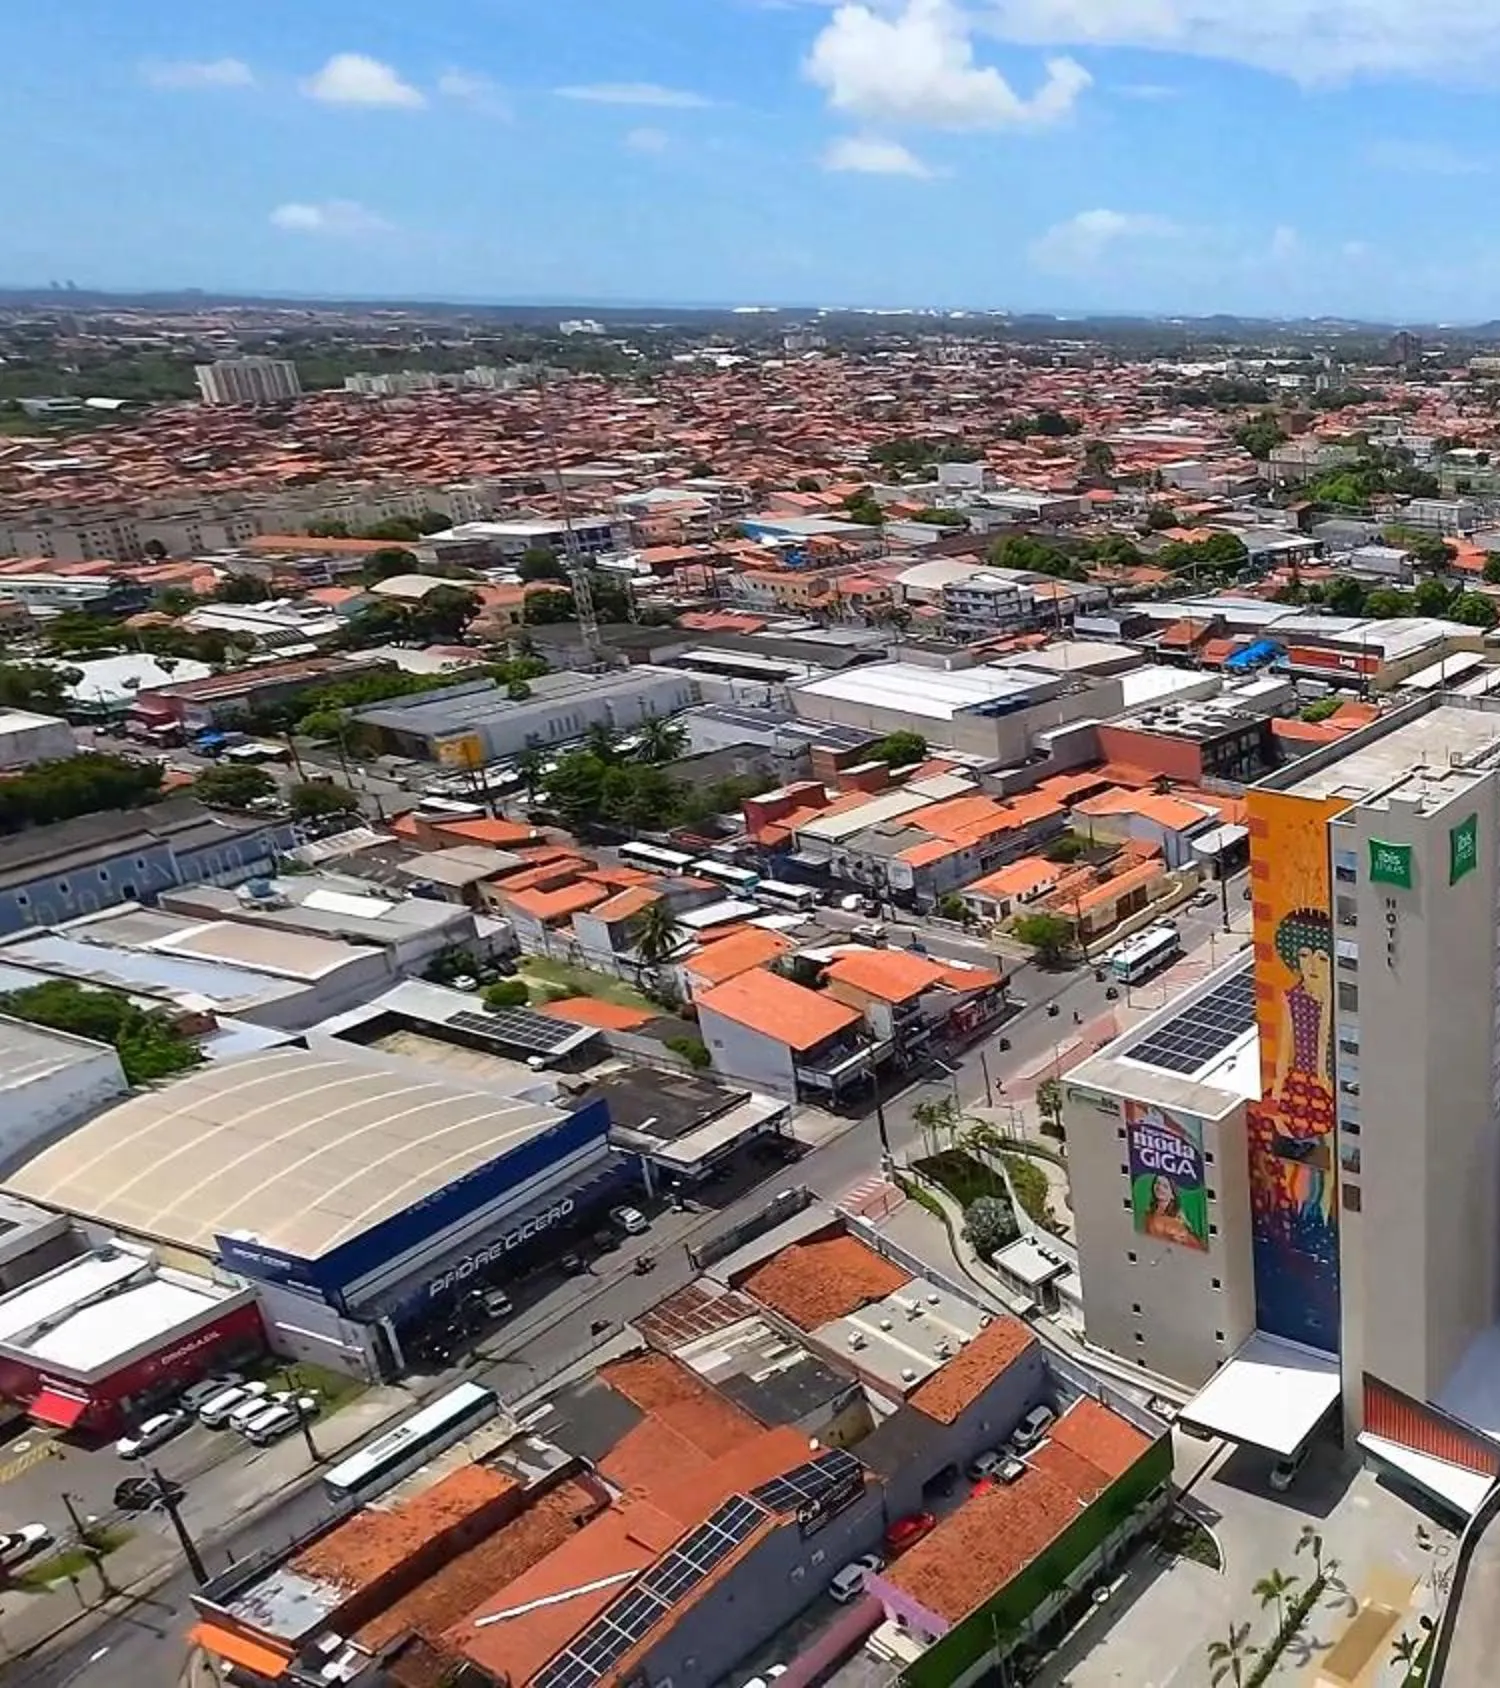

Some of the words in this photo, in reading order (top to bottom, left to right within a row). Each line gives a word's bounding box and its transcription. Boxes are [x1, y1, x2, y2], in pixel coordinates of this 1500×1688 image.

[1385, 898, 1397, 968] HOTEL
[1133, 1131, 1196, 1161] moda
[1139, 1149, 1197, 1180] GIGA
[504, 1199, 575, 1251] CICERO
